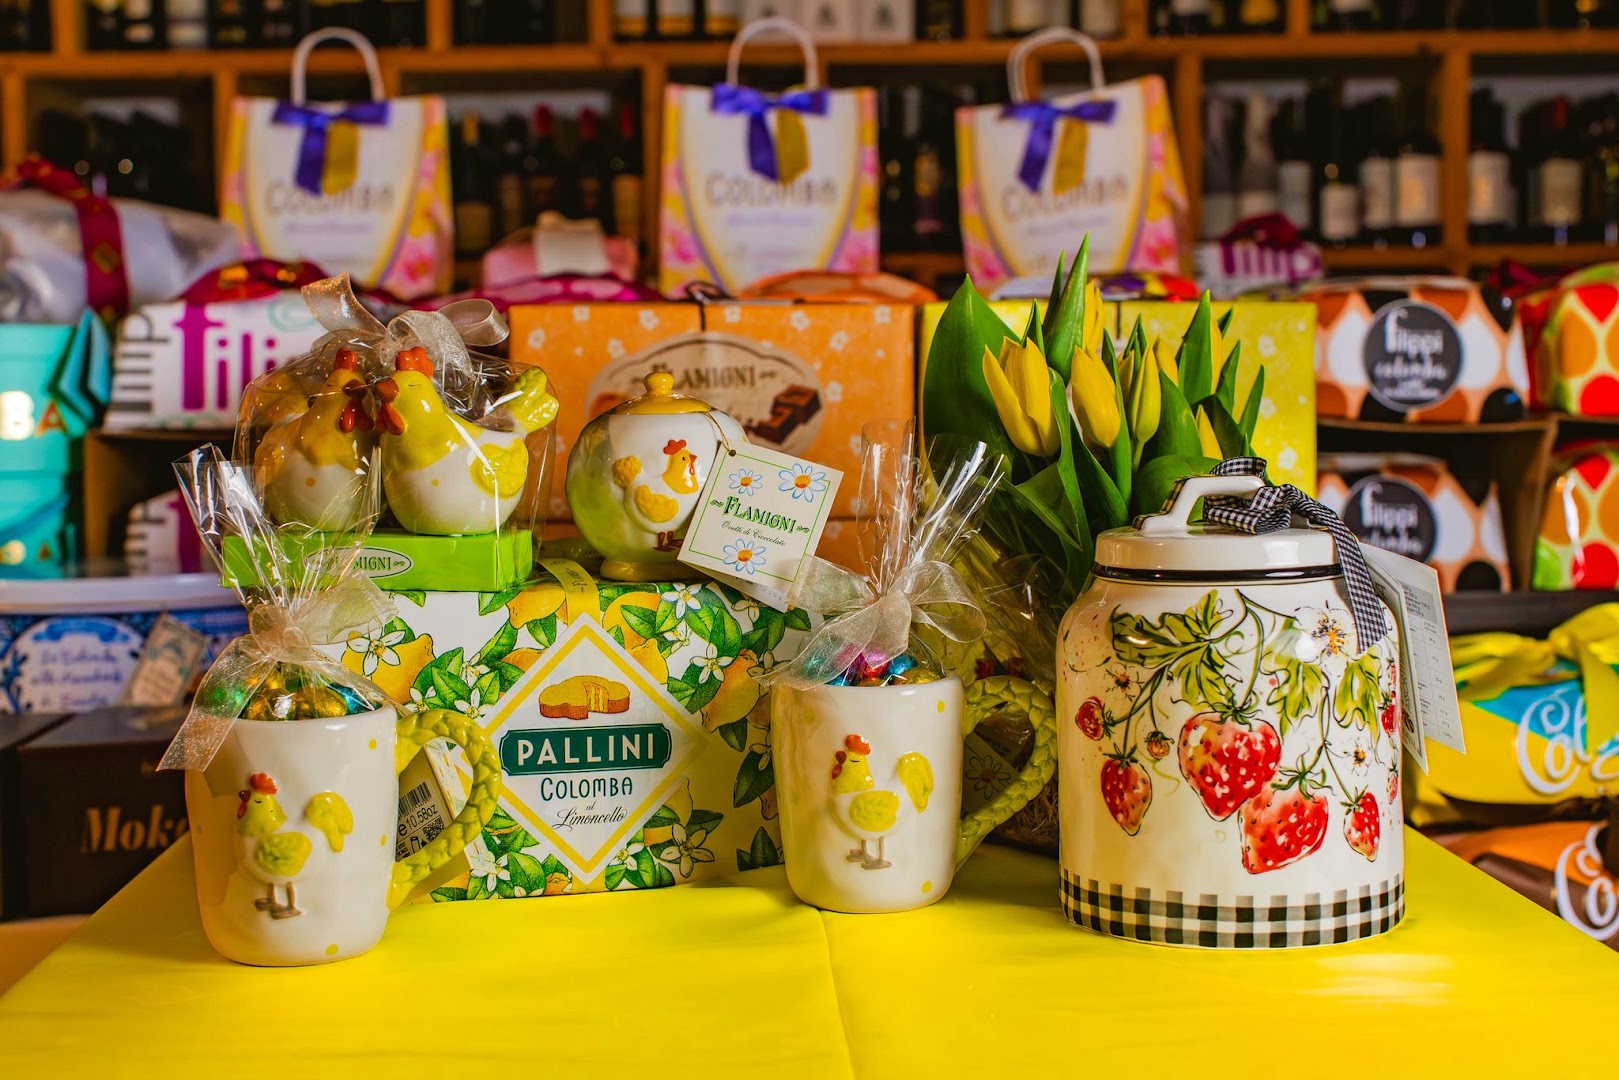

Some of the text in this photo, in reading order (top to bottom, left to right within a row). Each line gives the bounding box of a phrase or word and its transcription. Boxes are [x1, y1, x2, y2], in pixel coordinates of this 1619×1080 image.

[652, 362, 756, 390] AMIGNI
[722, 495, 796, 534] FLAMIGNI
[517, 733, 655, 766] PALLINI
[540, 777, 633, 801] COLOMBA
[406, 804, 439, 830] 10.58oz
[585, 800, 597, 811] al
[551, 806, 629, 832] Limoncello
